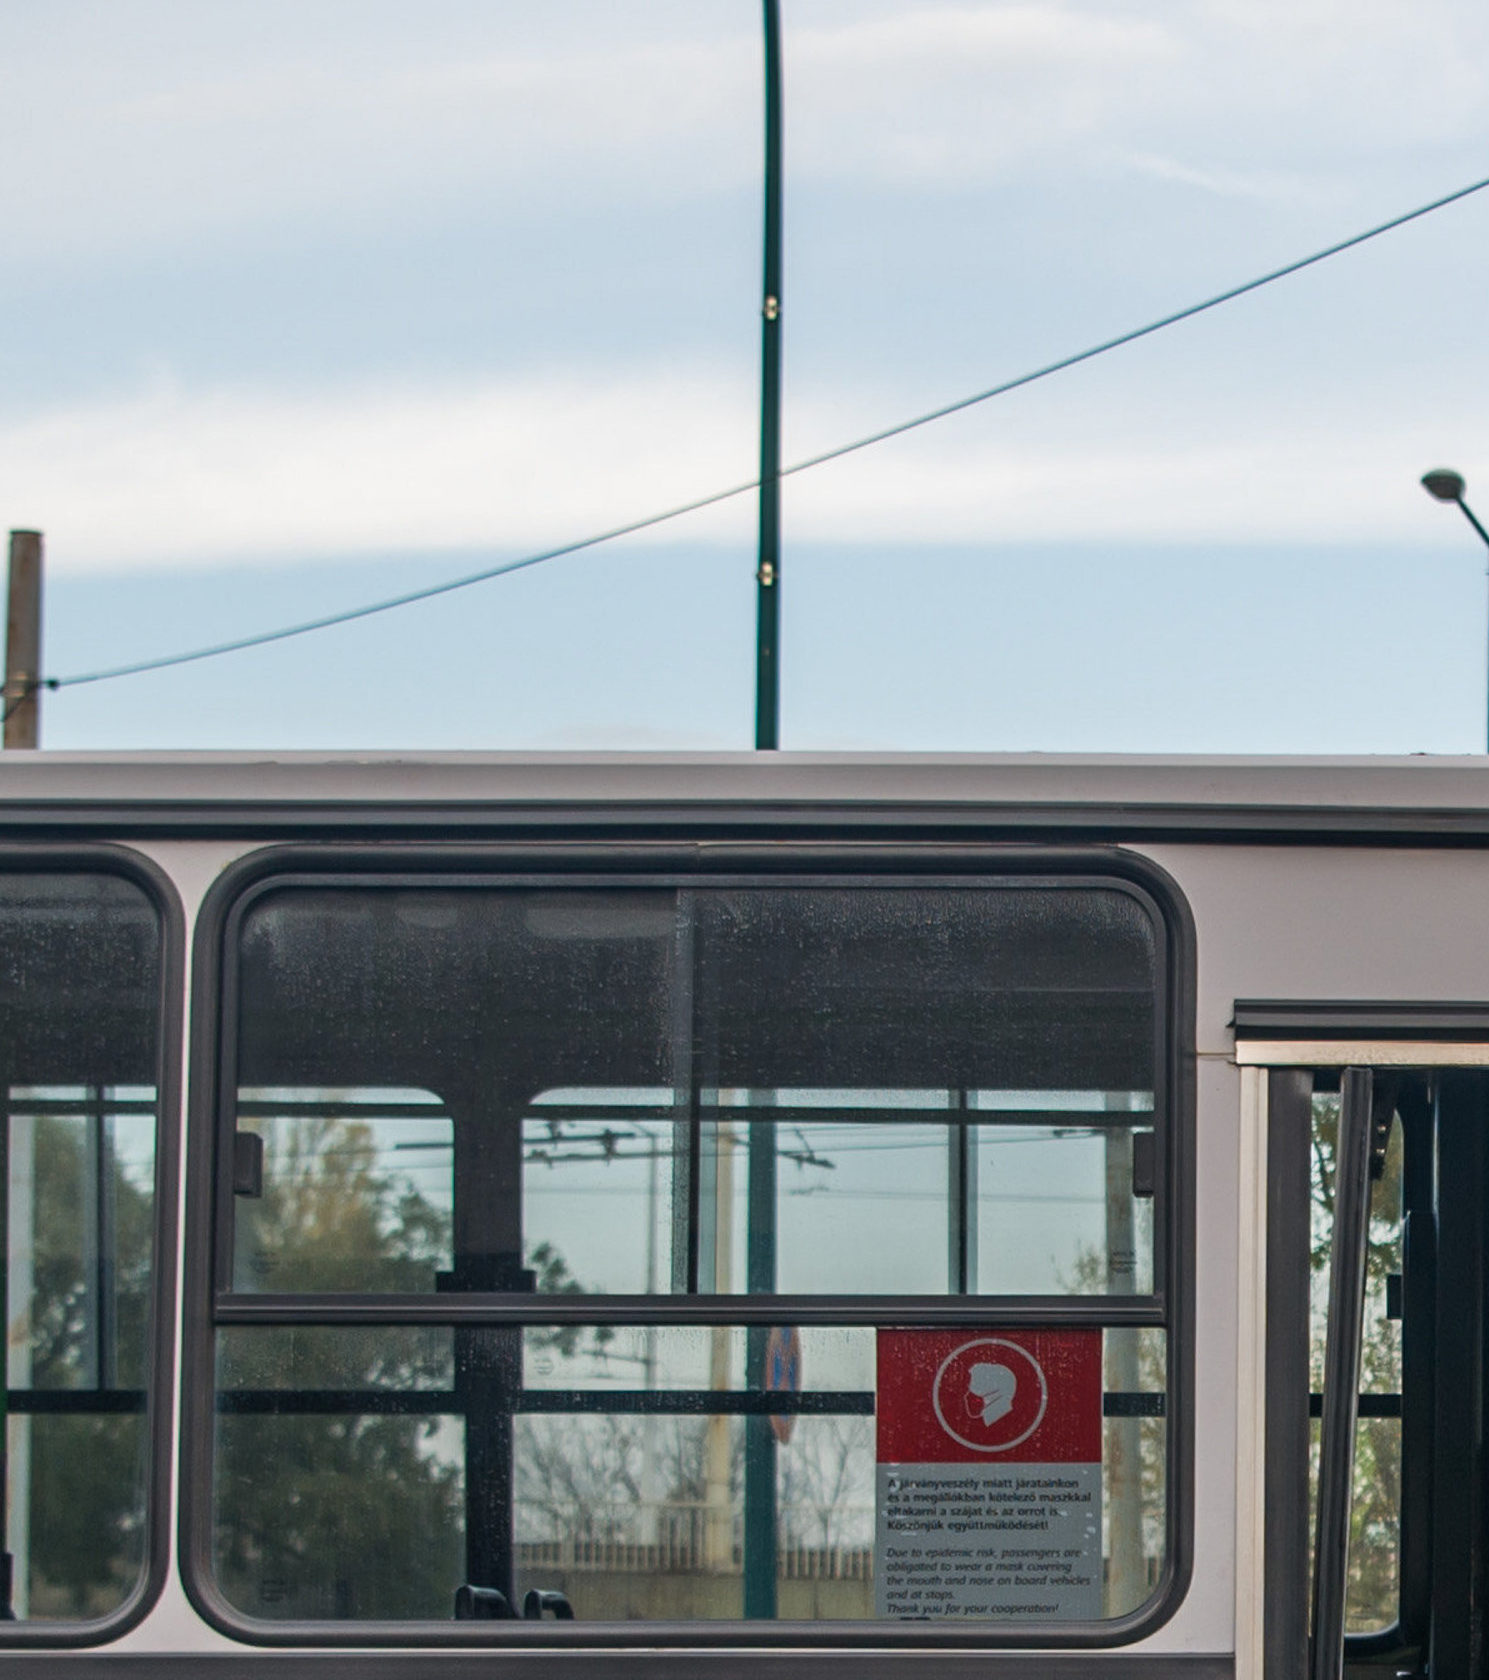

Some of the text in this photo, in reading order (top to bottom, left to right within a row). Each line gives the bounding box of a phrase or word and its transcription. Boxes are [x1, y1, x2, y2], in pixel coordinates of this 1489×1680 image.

[888, 1478, 1079, 1490] A járványveszély miatt járatainkon
[887, 1491, 900, 1501] és
[914, 1492, 985, 1504] megállókban
[988, 1491, 1037, 1501] kötelező
[1039, 1491, 1092, 1501] maszkkal
[887, 1506, 937, 1516] eltakarni
[951, 1506, 983, 1519] szájat
[986, 1506, 998, 1516] és
[1018, 1508, 1046, 1516] orrot
[887, 1519, 944, 1532] Köszönjük
[887, 1548, 908, 1557] Due
[912, 1548, 922, 1557] to
[925, 1548, 972, 1560] epidemic
[976, 1548, 998, 1560] risk,
[1000, 1549, 1060, 1560] passengers
[887, 1561, 937, 1574] obligated
[940, 1562, 952, 1571] to
[955, 1563, 981, 1571] wear
[996, 1561, 1023, 1571] mask
[1027, 1561, 1072, 1574] covering
[887, 1575, 902, 1585] the
[906, 1575, 942, 1585] mouth
[944, 1575, 966, 1585] and
[1014, 1575, 1048, 1585] board
[1050, 1575, 1091, 1585] vehicles
[887, 1589, 955, 1602] and at stops.
[887, 1602, 1060, 1616] Thank you for your cooperation!
